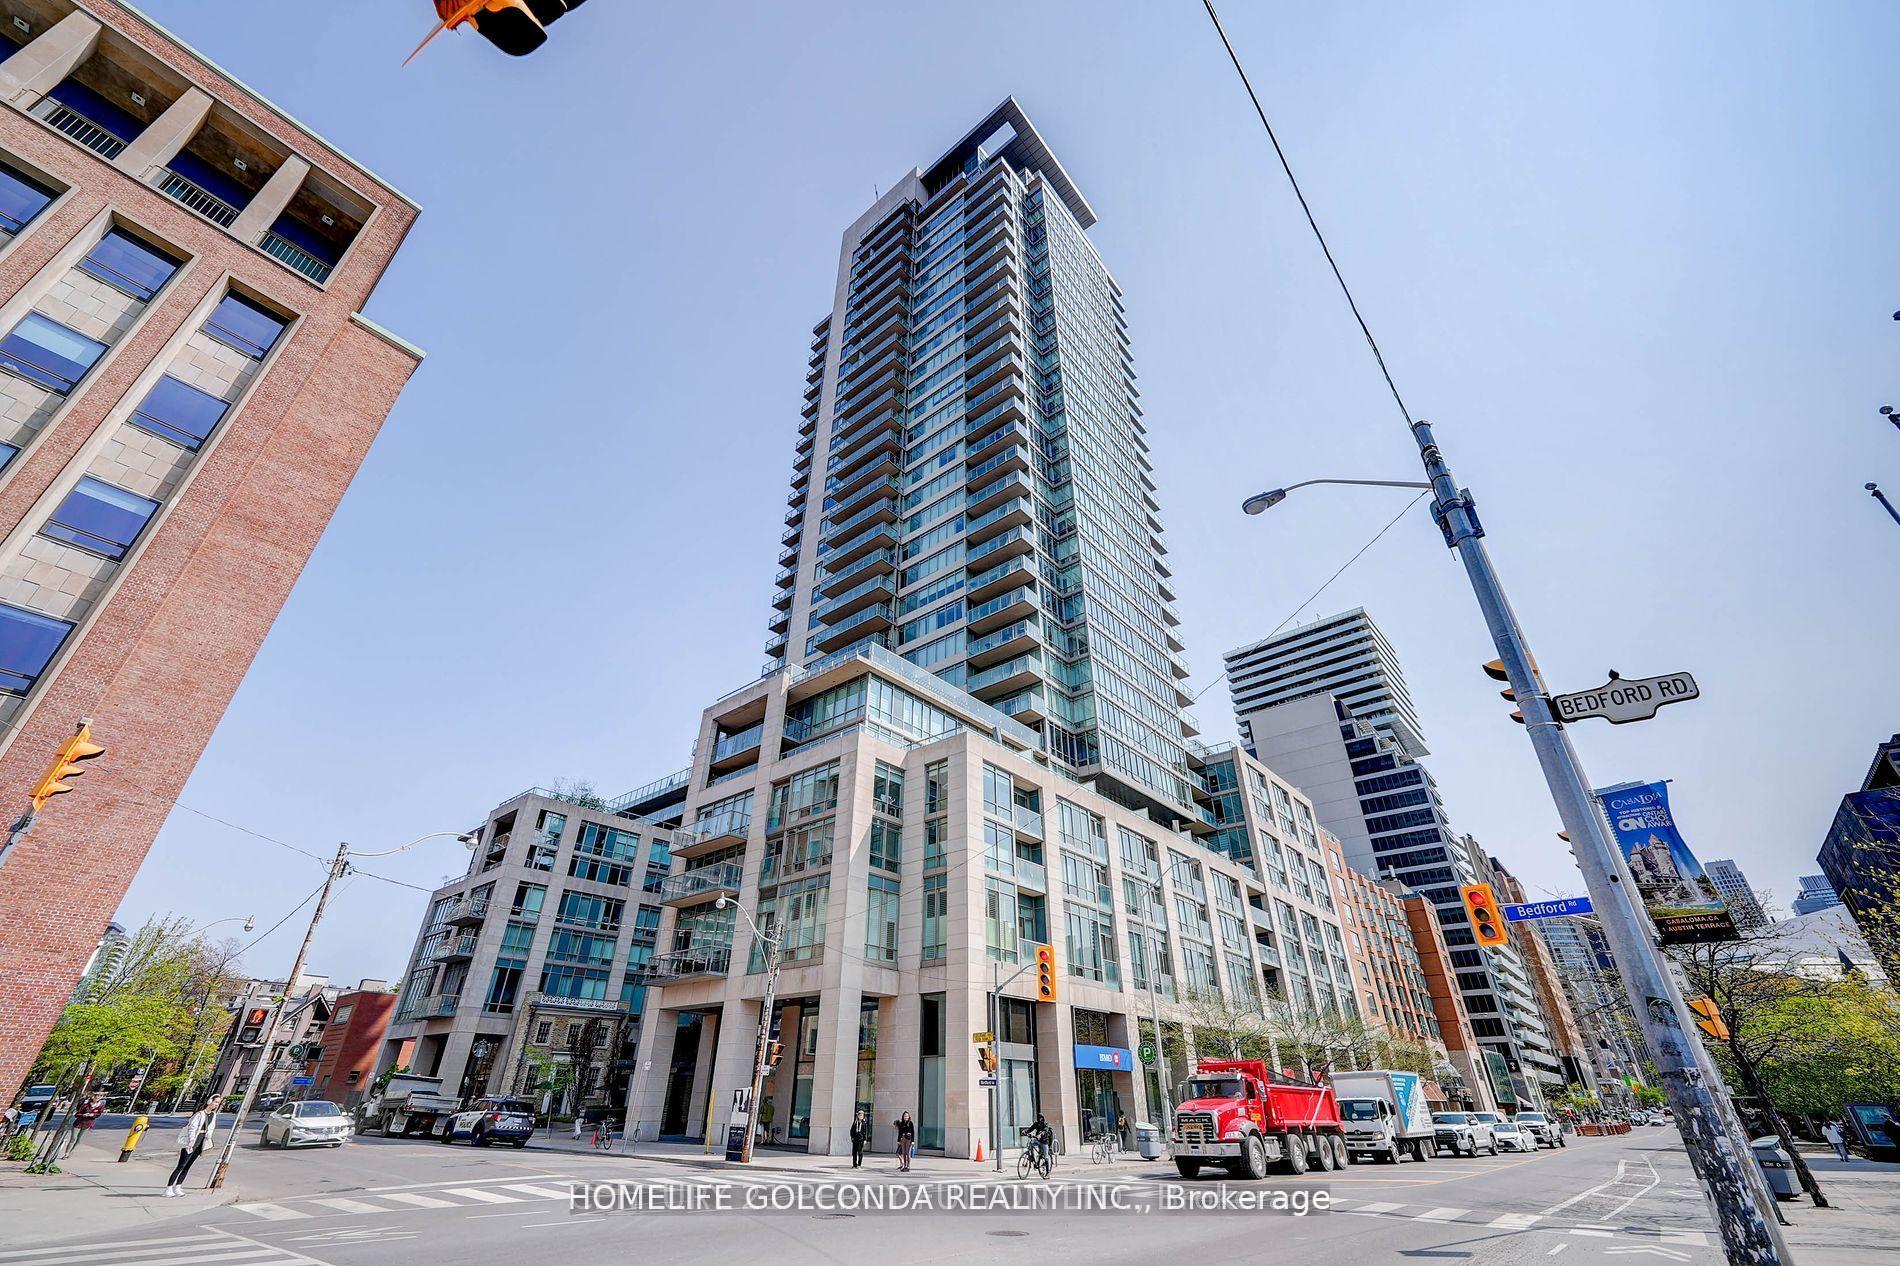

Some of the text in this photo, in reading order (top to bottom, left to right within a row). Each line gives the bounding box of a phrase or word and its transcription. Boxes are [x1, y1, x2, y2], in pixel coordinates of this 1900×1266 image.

[1560, 679, 1694, 715] BEDFORD RD.
[1618, 817, 1646, 831] ON
[1517, 902, 1567, 916] Bedford
[1666, 916, 1719, 924] CASALOMA.CA
[1099, 1053, 1112, 1062] BMO
[1144, 1047, 1150, 1057] P
